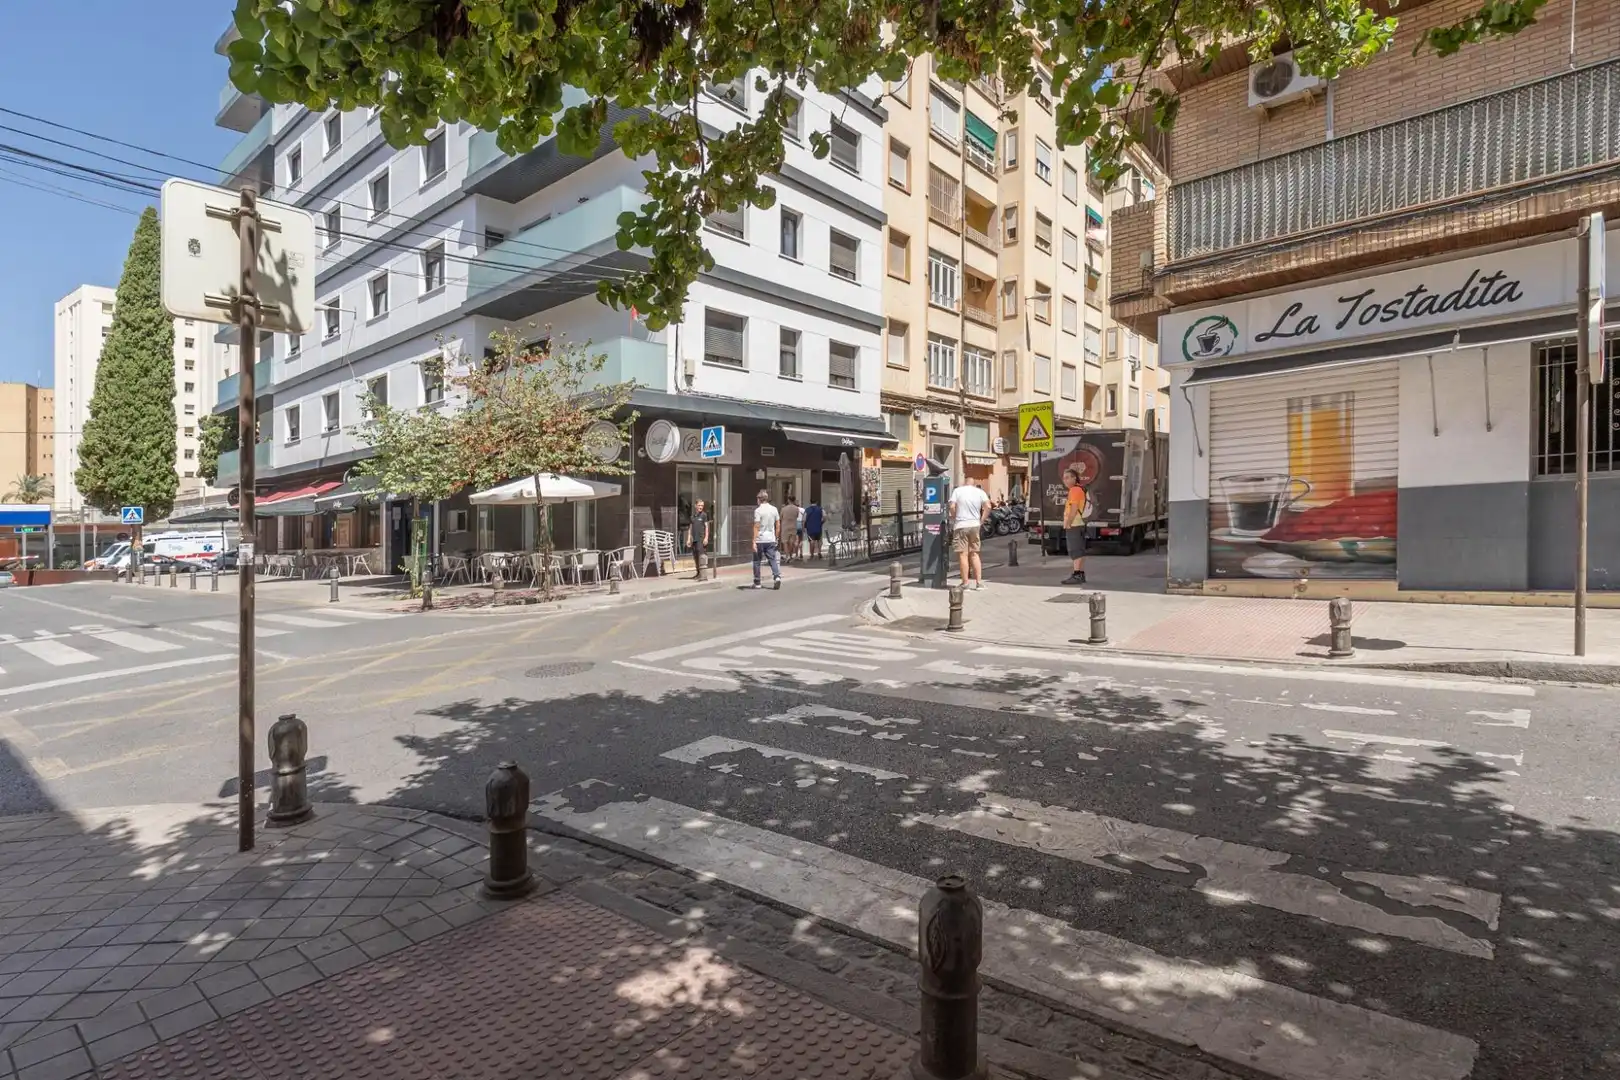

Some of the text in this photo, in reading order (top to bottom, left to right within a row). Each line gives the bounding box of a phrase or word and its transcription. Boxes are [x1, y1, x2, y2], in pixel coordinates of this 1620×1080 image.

[1254, 268, 1524, 342] La Tostadita
[1022, 441, 1050, 449] COLEGIO
[926, 487, 937, 501] P
